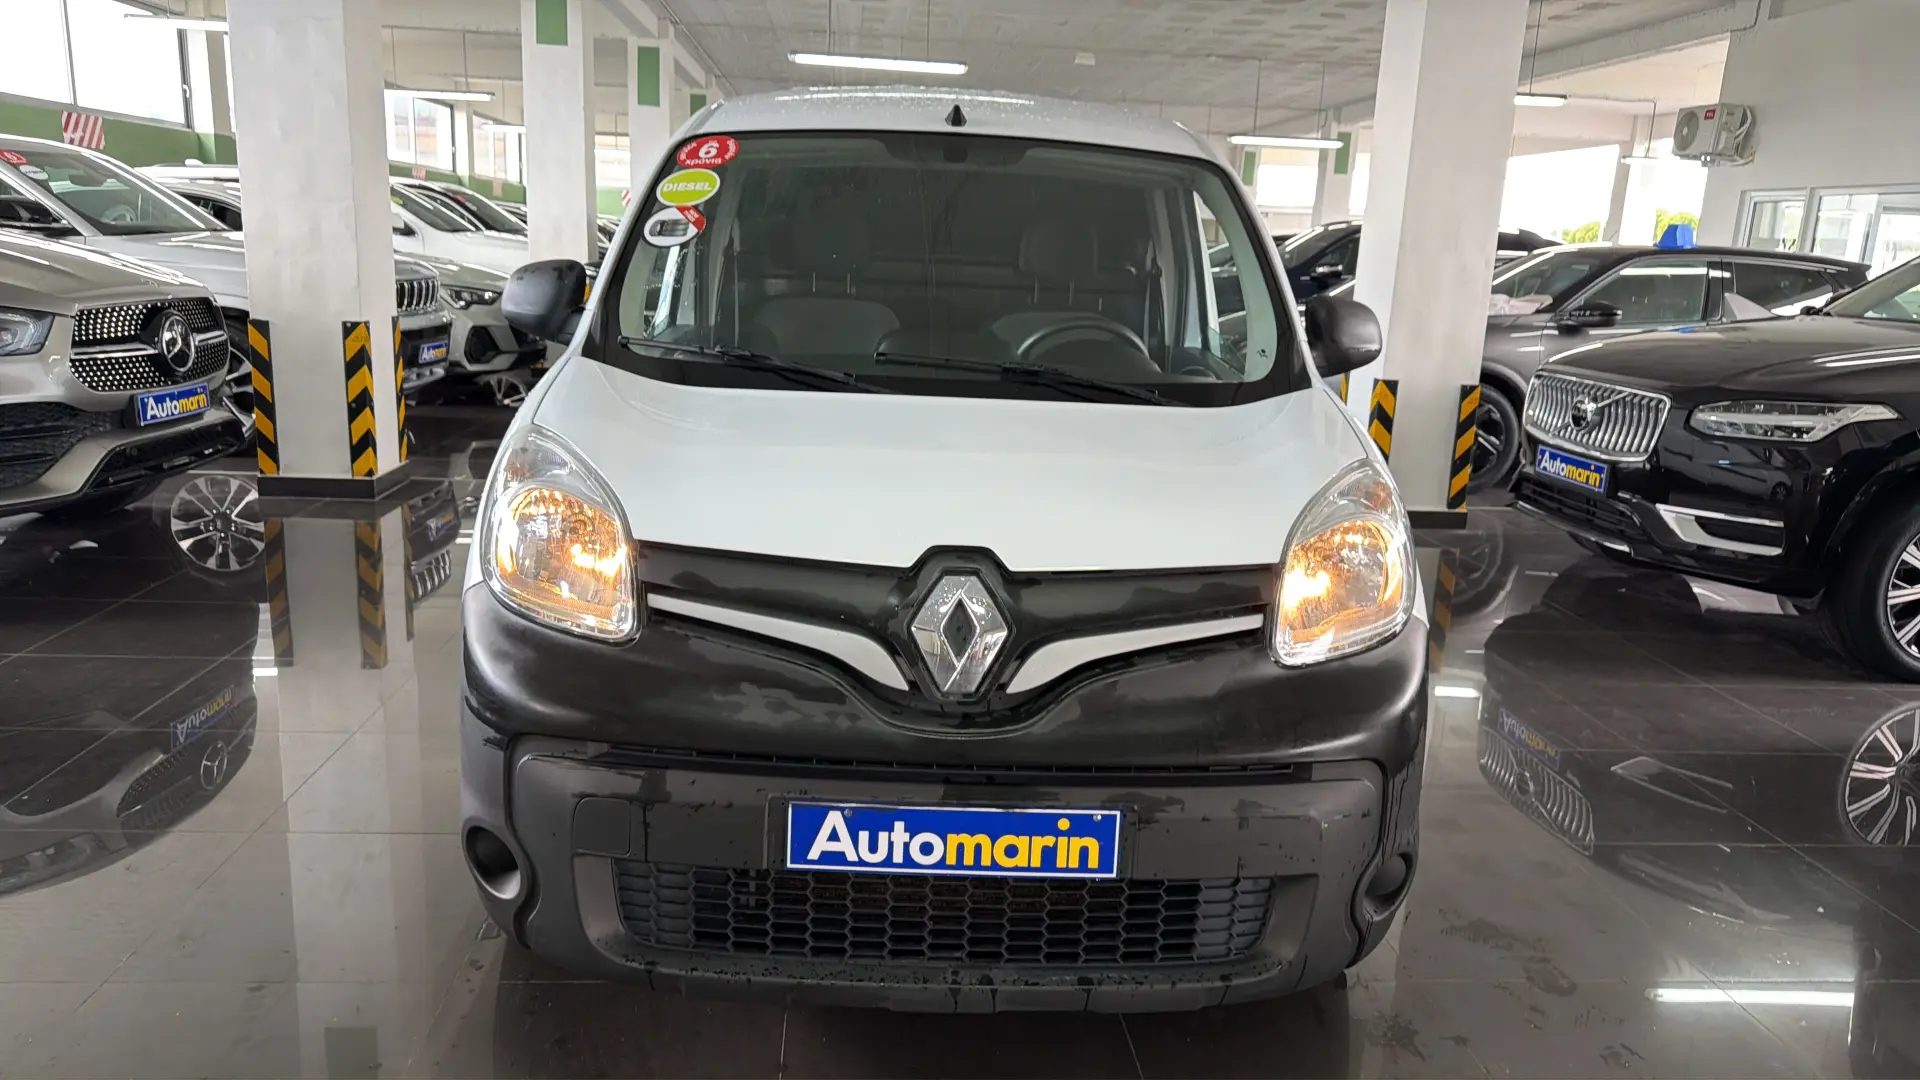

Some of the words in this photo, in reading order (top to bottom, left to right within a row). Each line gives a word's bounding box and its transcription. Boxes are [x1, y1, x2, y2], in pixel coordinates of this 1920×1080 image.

[698, 142, 719, 158] 6
[663, 182, 712, 191] DIESEL
[146, 387, 208, 420] Automarin
[1540, 451, 1600, 487] Automarin
[807, 810, 1098, 869] Automarin
